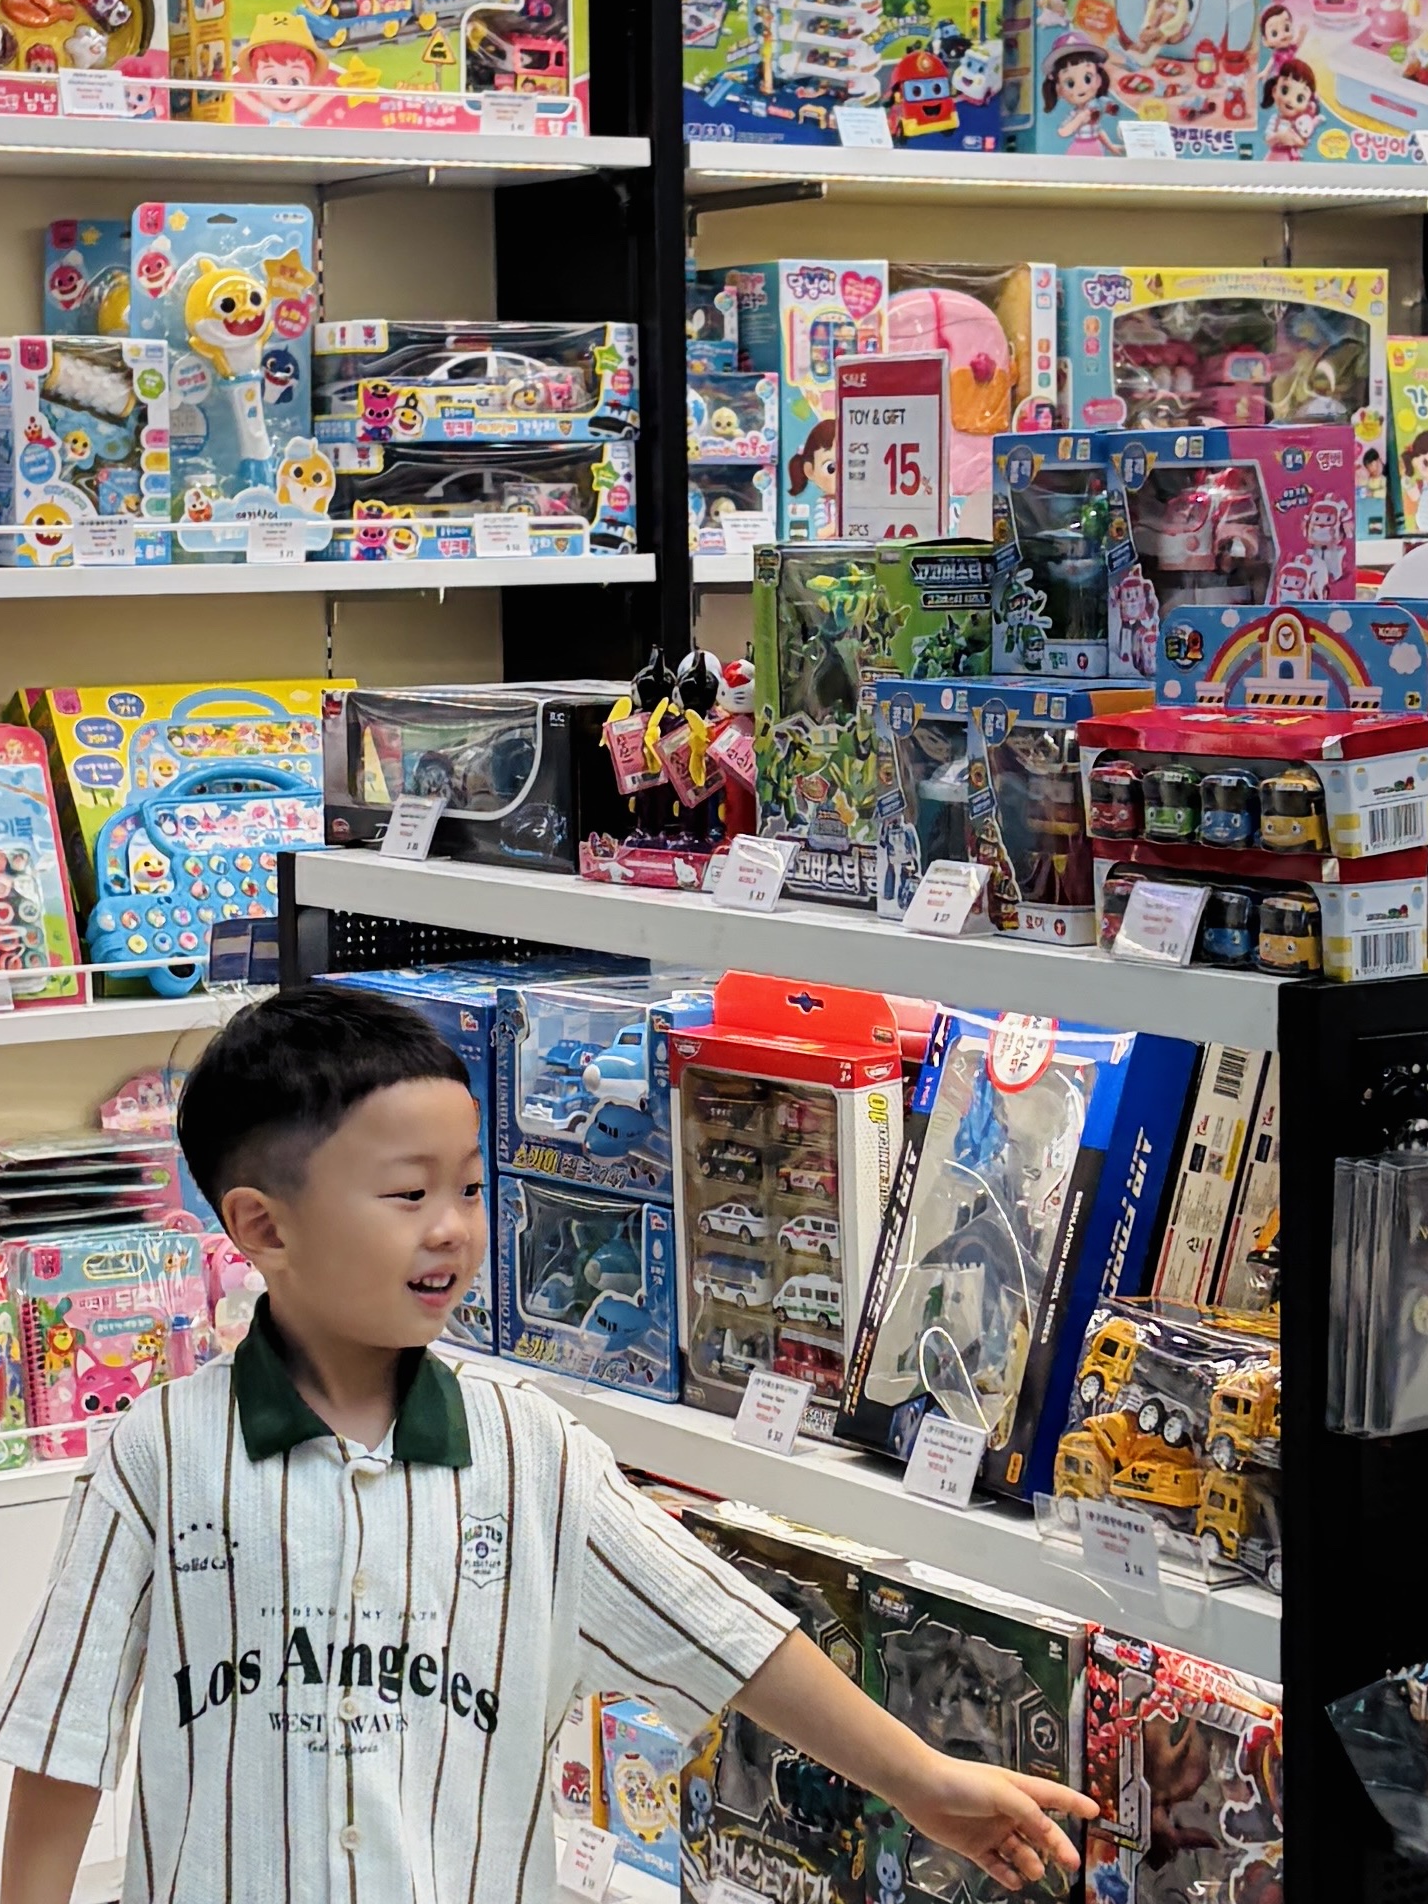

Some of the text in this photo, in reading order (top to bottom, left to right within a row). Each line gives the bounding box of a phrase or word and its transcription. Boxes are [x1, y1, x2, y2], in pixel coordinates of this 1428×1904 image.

[1352, 132, 1407, 162] 달님이
[842, 372, 866, 388] SALE
[848, 409, 906, 426] TOY & GIFT
[848, 524, 869, 537] 2PCS
[895, 1140, 917, 1208] AIR
[1100, 1126, 1153, 1300] AIR FORC
[1049, 1260, 1067, 1301] MODEL
[174, 1625, 500, 1733] Los Angeles
[269, 1712, 324, 1733] WEST
